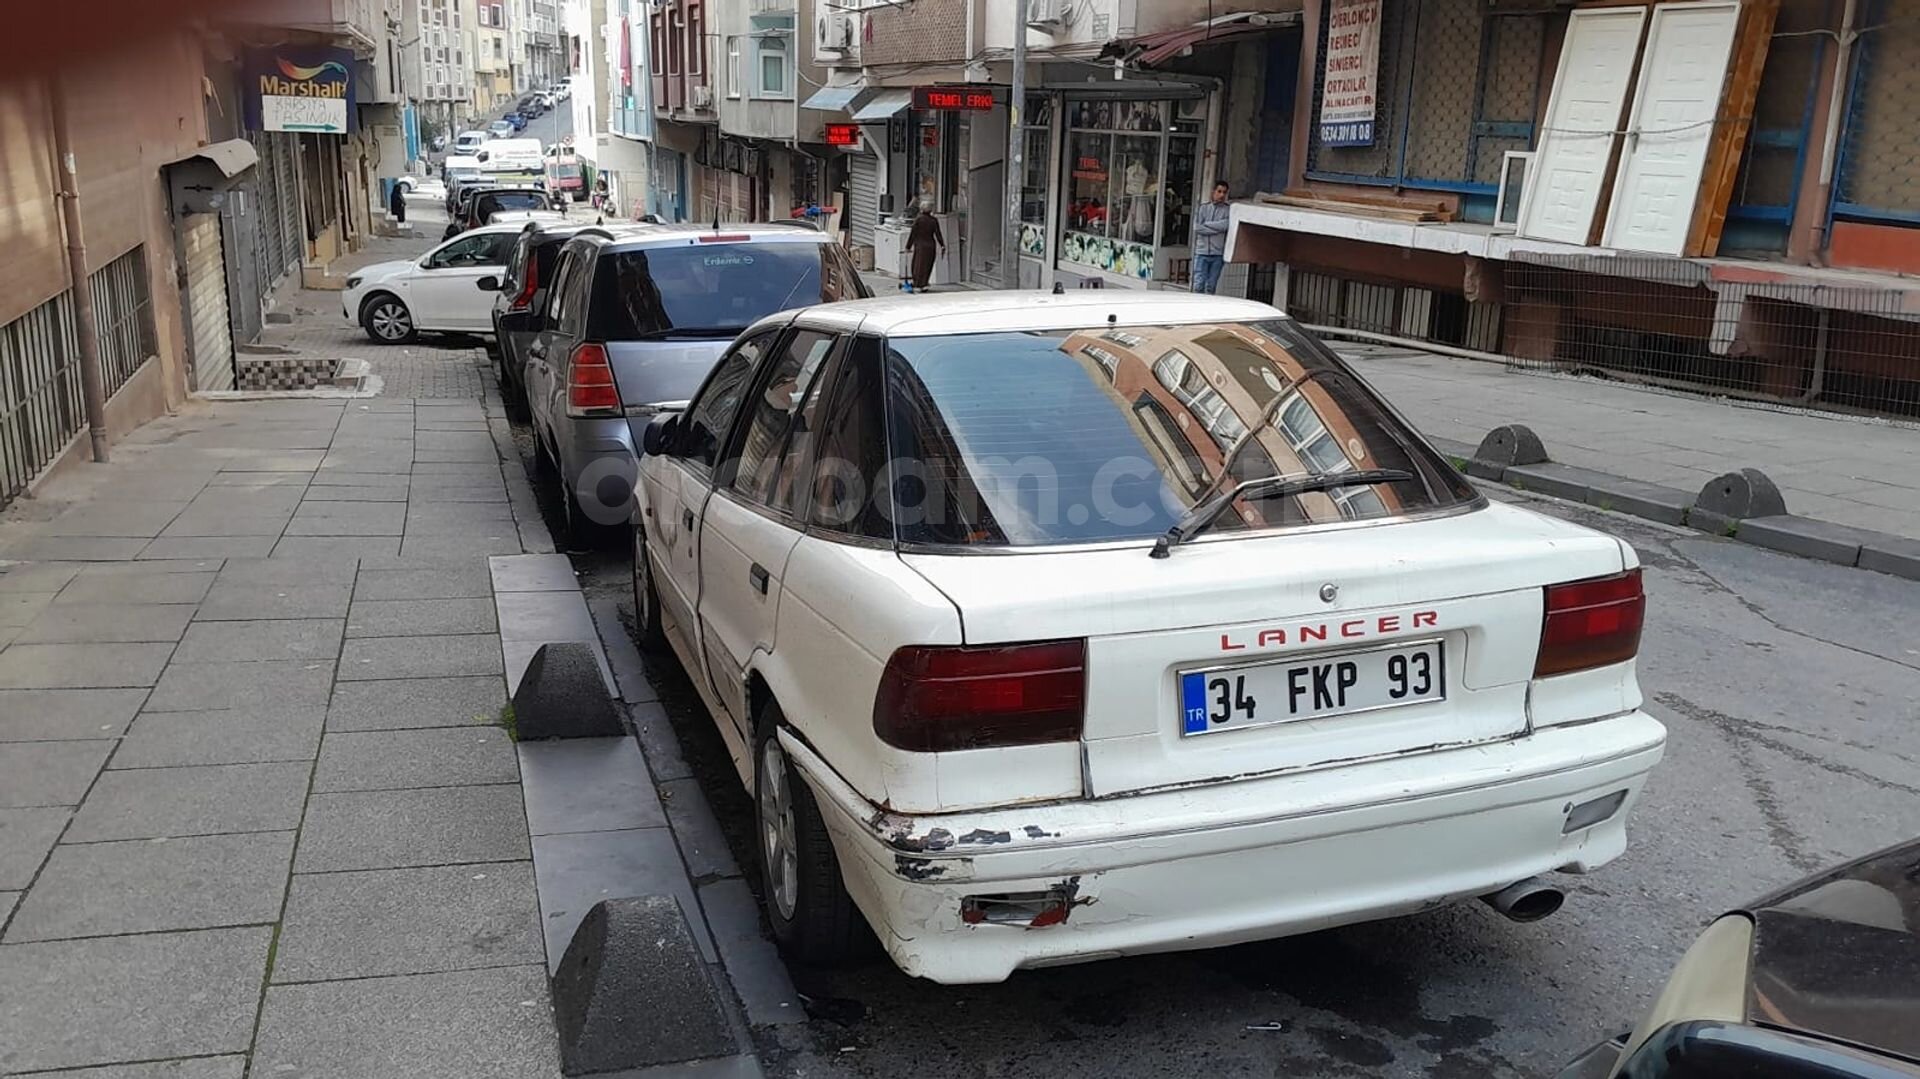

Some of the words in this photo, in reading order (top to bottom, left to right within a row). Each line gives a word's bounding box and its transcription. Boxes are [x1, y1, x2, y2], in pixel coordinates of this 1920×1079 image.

[260, 74, 341, 98] Marshall
[928, 93, 962, 106] TEMEL
[1221, 610, 1438, 650] LANCER
[1208, 675, 1256, 724] 34
[1288, 661, 1357, 713] FKP
[1388, 652, 1431, 699] 93
[1187, 708, 1205, 722] TR
